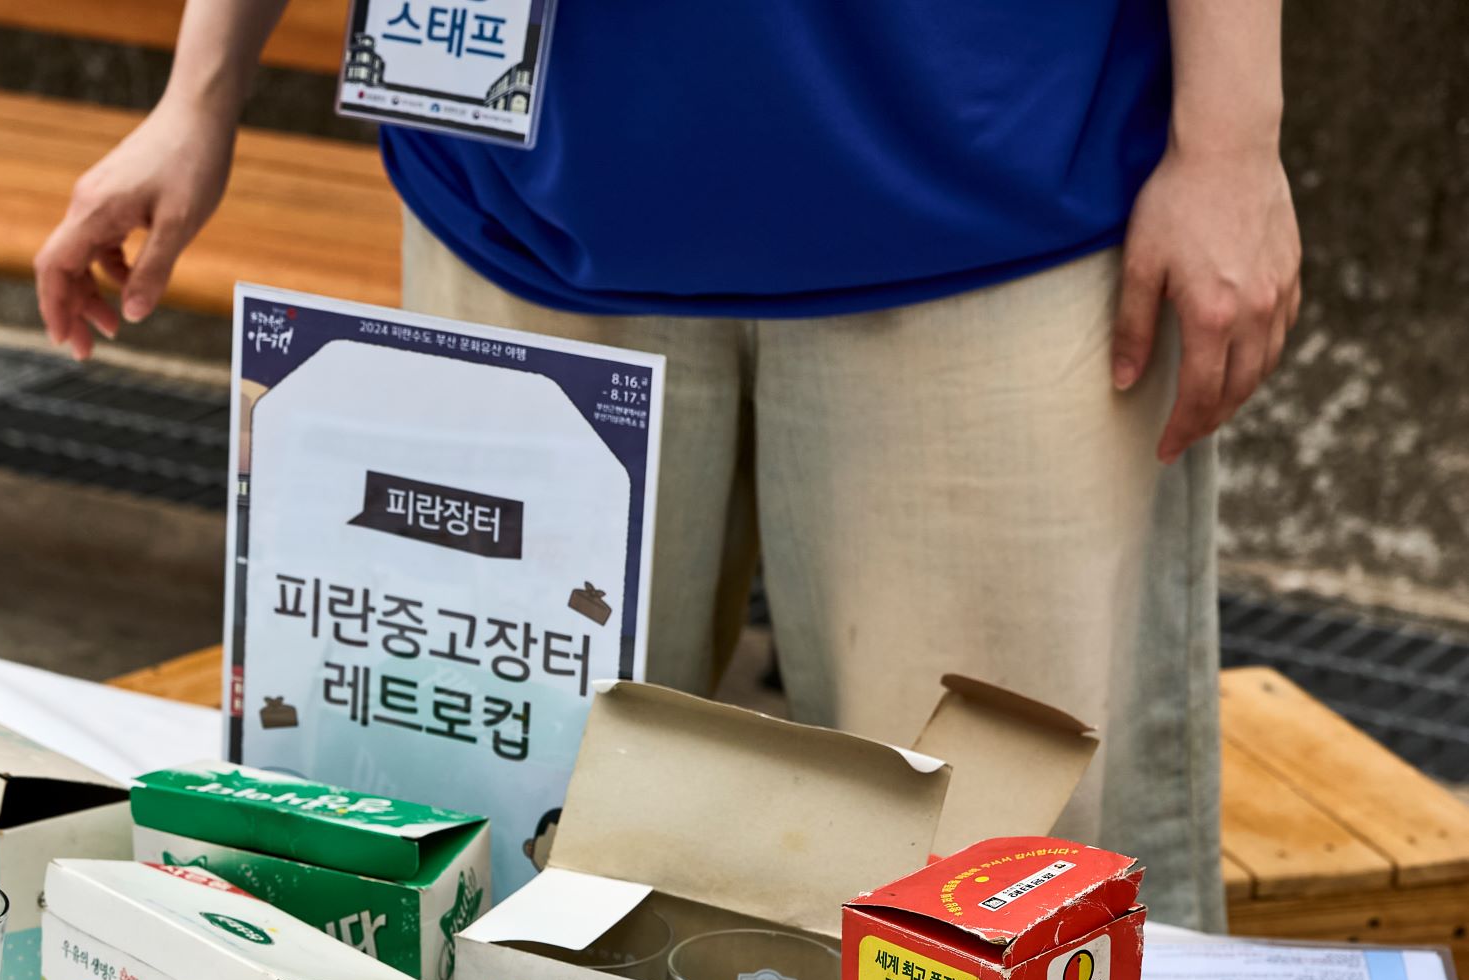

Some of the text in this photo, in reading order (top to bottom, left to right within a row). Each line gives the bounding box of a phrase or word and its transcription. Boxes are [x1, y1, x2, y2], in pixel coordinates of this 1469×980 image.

[383, 2, 506, 59] 스태프
[359, 321, 388, 336] 2024
[436, 333, 456, 349] 부산
[386, 488, 501, 543] 피란장터
[274, 573, 591, 697] 피란중고장터
[323, 662, 531, 762] 레트로컵
[875, 949, 900, 975] 세계
